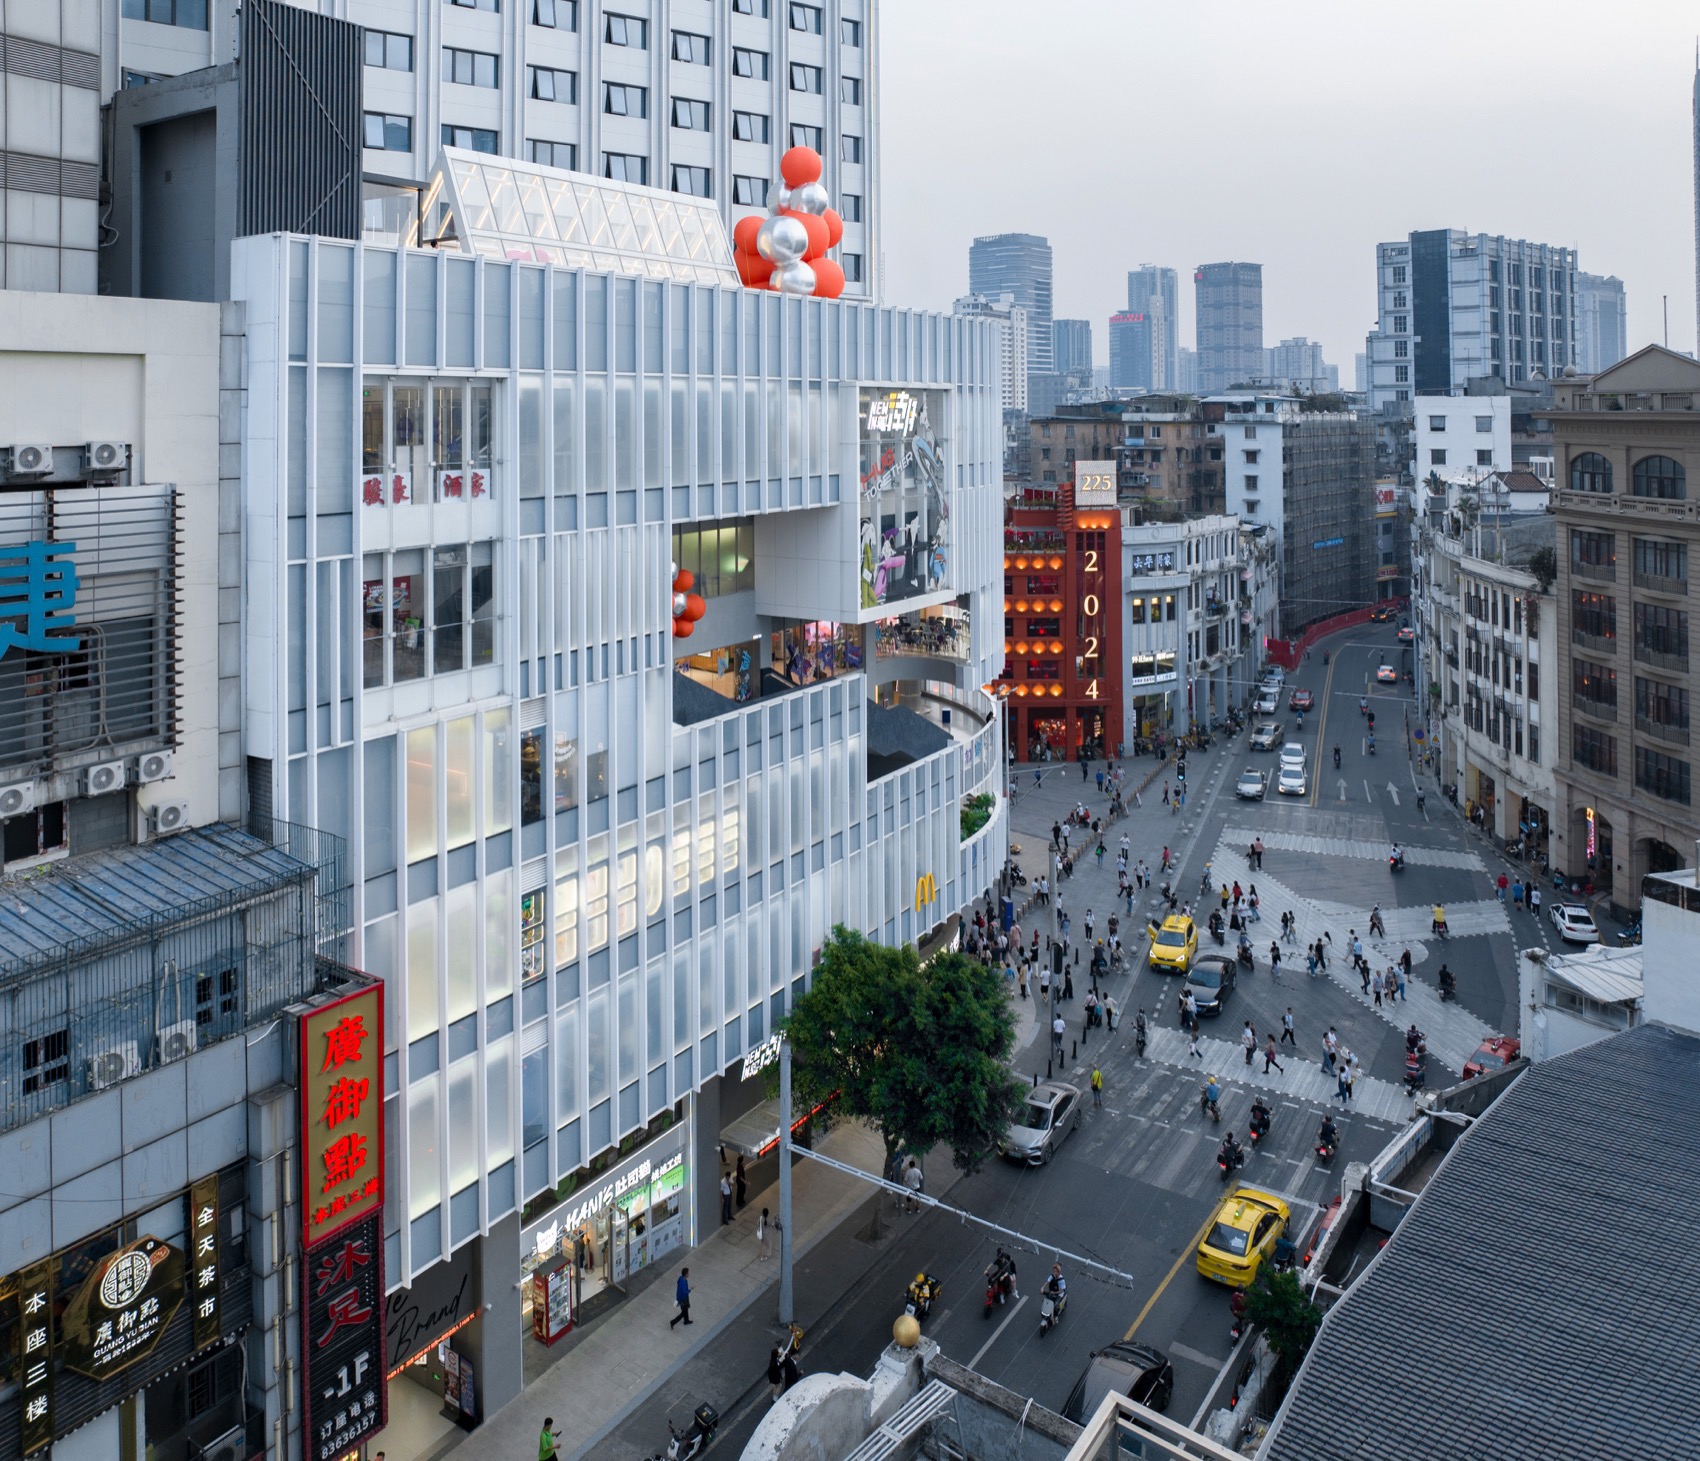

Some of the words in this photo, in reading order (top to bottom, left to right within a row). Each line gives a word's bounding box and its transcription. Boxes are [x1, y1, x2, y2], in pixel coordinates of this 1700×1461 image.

[861, 447, 895, 491] HUG
[864, 451, 914, 502] TOGETHER
[1081, 475, 1112, 491] 225
[197, 1206, 216, 1318] 全天茶市
[317, 1240, 374, 1347] 沐足
[25, 1291, 48, 1423] 本座三楼
[93, 1335, 125, 1358] GUANG
[125, 1328, 138, 1342] YU
[320, 1390, 376, 1441] 订座电话
[321, 1411, 376, 1461] 83636157
